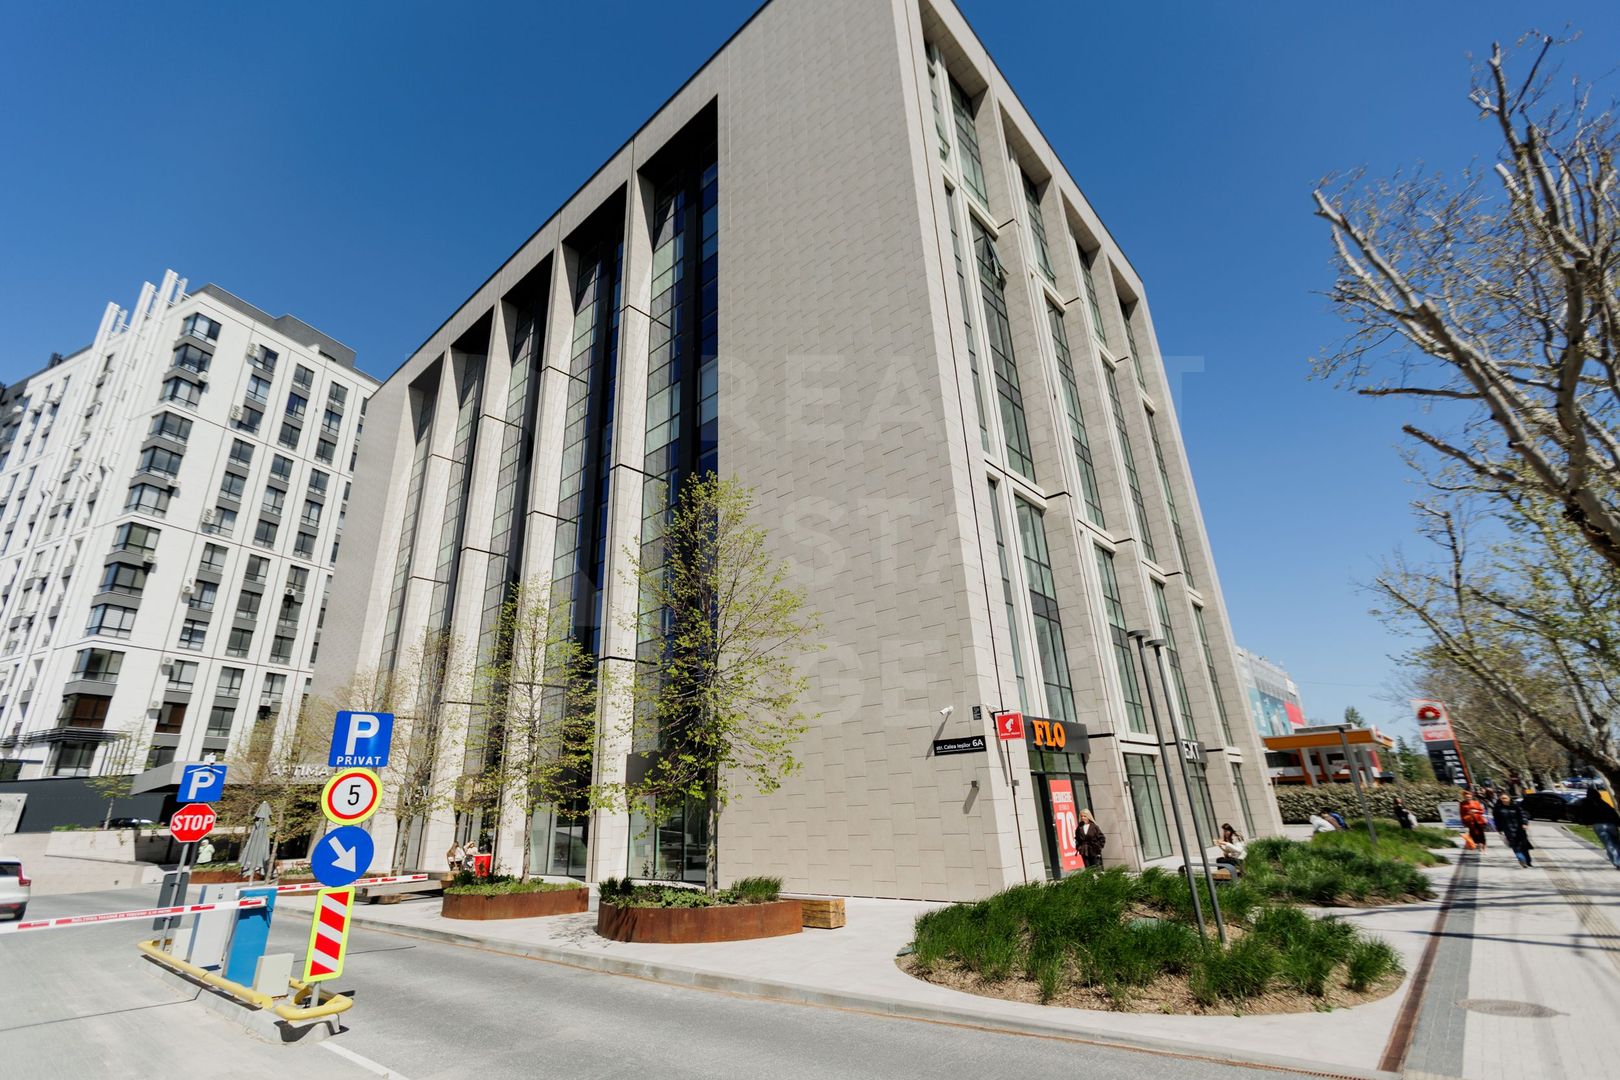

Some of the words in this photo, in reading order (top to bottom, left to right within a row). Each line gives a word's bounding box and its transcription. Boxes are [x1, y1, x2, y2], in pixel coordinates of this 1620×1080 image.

[344, 713, 380, 755] P
[972, 739, 984, 747] 6A
[1032, 720, 1066, 748] FLO
[336, 756, 381, 765] PRIVAT
[1181, 741, 1200, 760] EXT
[187, 771, 216, 800] P
[347, 784, 361, 806] 5
[171, 814, 215, 831] STOP
